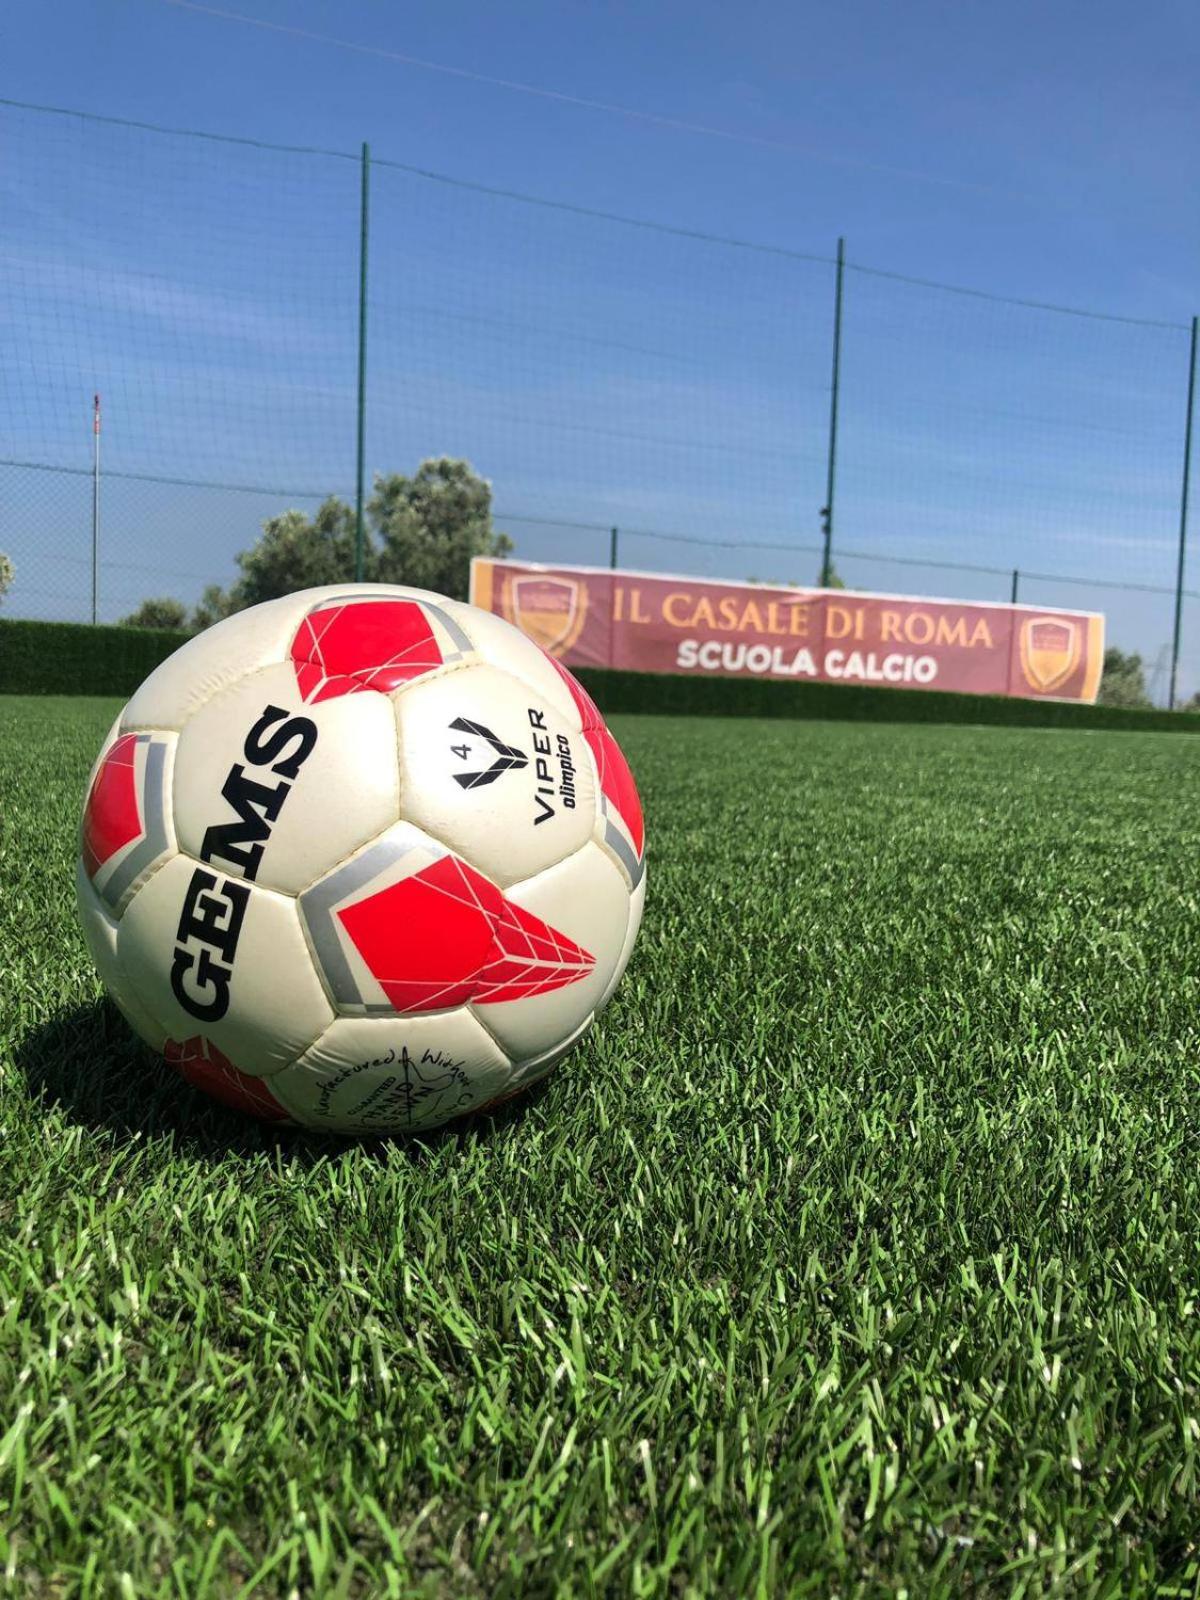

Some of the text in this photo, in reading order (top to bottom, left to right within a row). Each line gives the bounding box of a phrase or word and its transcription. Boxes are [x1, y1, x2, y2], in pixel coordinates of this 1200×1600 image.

[612, 587, 652, 624] IL
[661, 593, 809, 637] CASALE
[825, 604, 866, 641] DI
[880, 609, 994, 650] ROMA
[676, 638, 939, 684] SCUOLA CALCIO
[450, 744, 473, 761] 4
[527, 707, 556, 827] VIPER
[556, 734, 577, 810] olimpico
[170, 704, 318, 1023] GEMS
